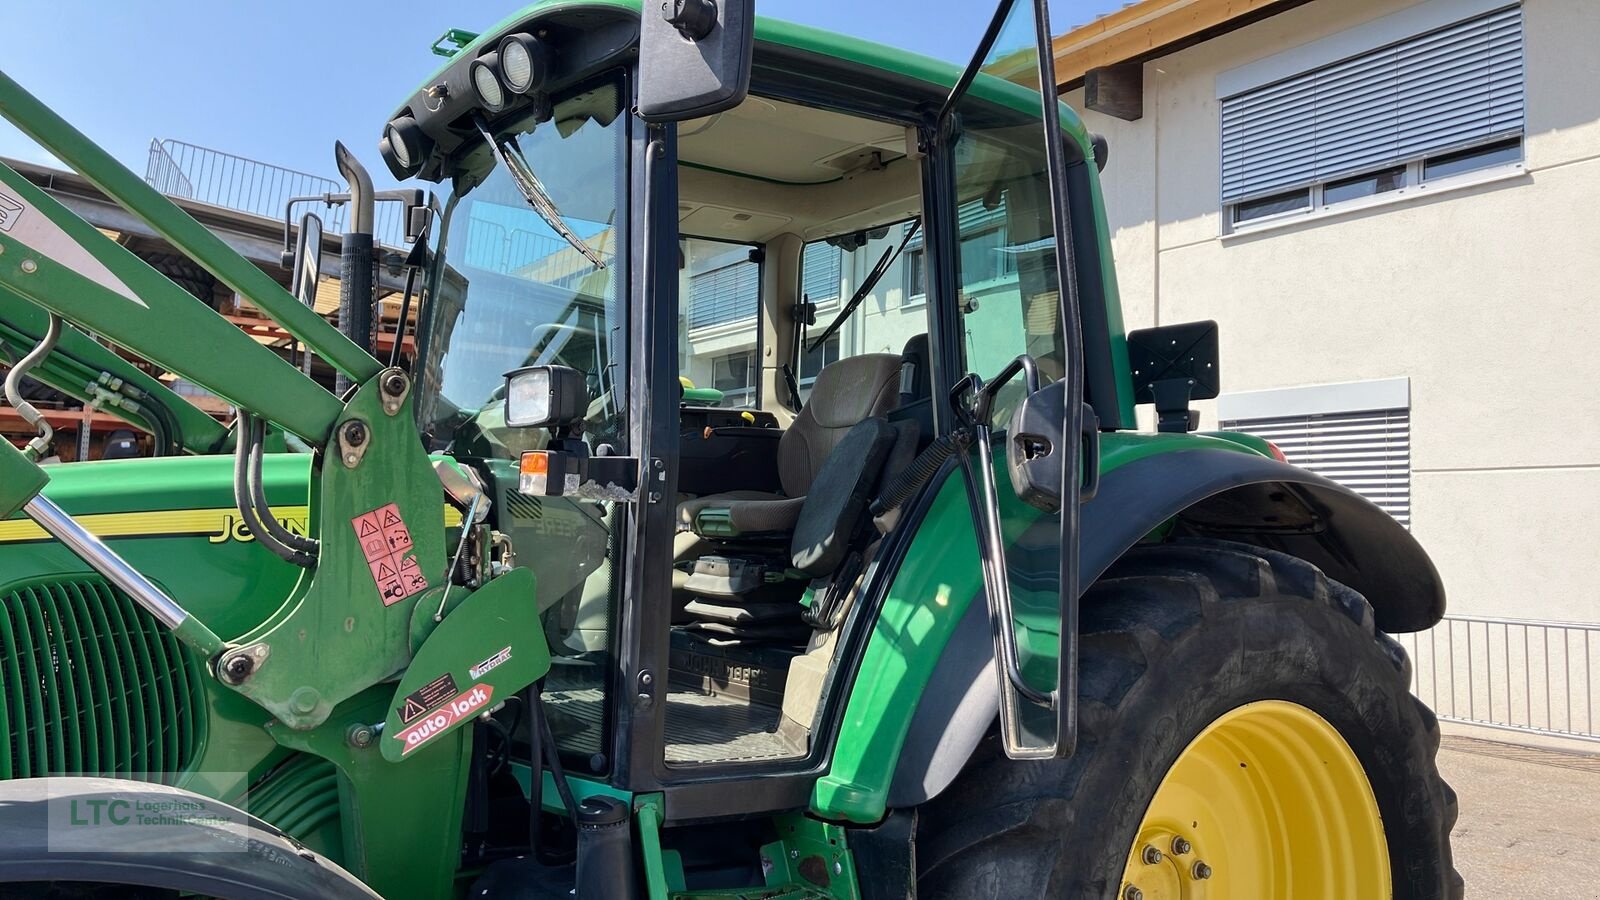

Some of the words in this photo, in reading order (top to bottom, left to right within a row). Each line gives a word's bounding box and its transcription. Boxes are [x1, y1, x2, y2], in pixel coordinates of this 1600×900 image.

[209, 514, 308, 543] JON
[407, 715, 447, 745] auto
[451, 688, 488, 717] lock
